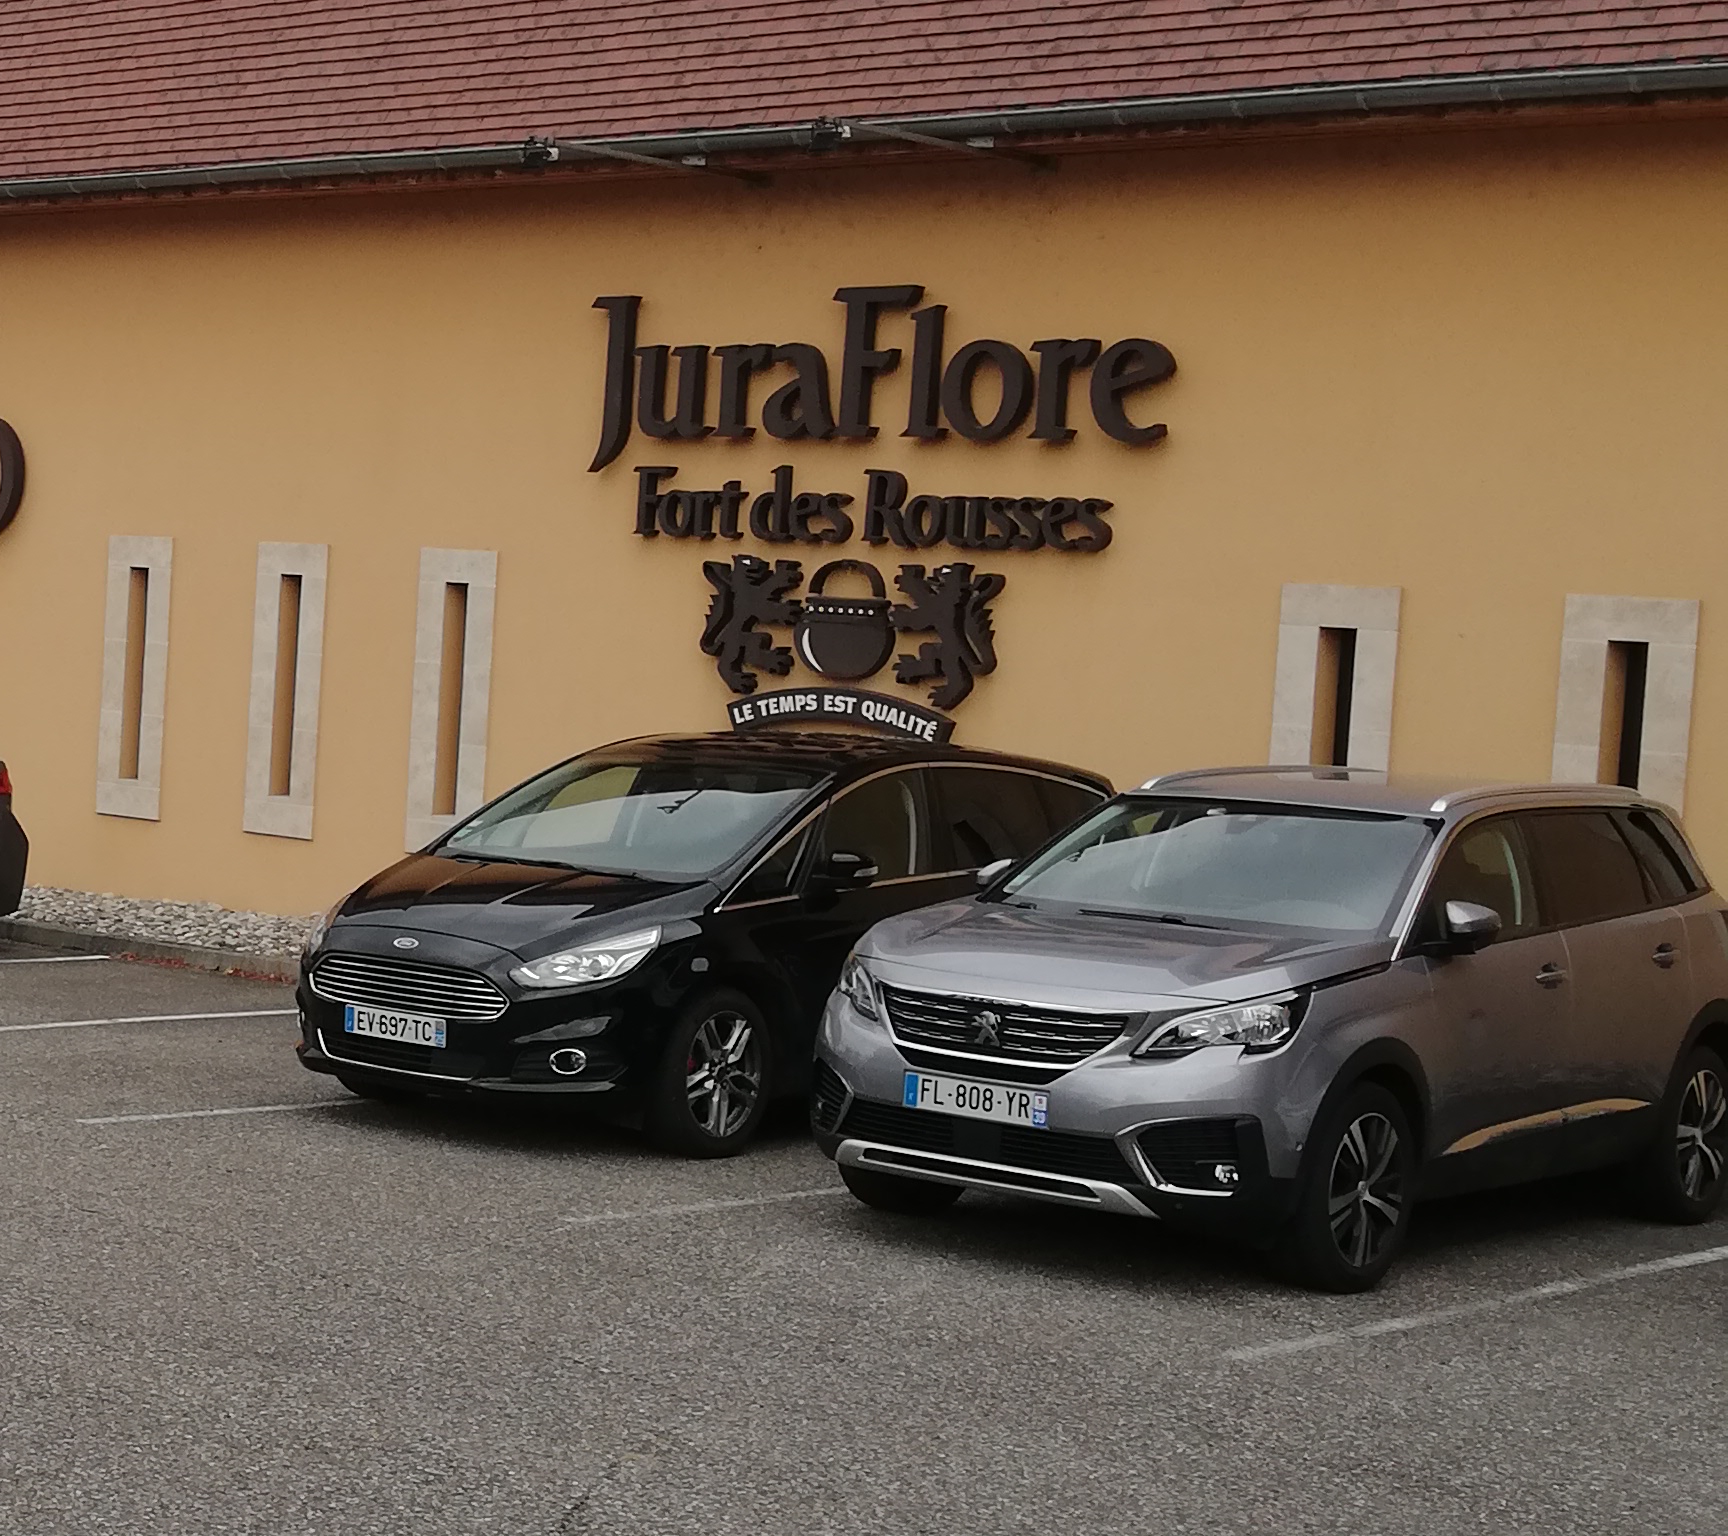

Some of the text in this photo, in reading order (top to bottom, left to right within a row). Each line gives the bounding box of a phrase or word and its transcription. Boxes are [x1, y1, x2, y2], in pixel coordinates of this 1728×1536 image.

[587, 284, 1177, 472] JuraFlore
[633, 465, 1114, 552] Fort des Rousses
[733, 694, 939, 742] LE TEMPS EST QUALITÉ
[357, 1010, 432, 1042] EV-697-TC
[920, 1078, 1031, 1119] FL-808-YR
